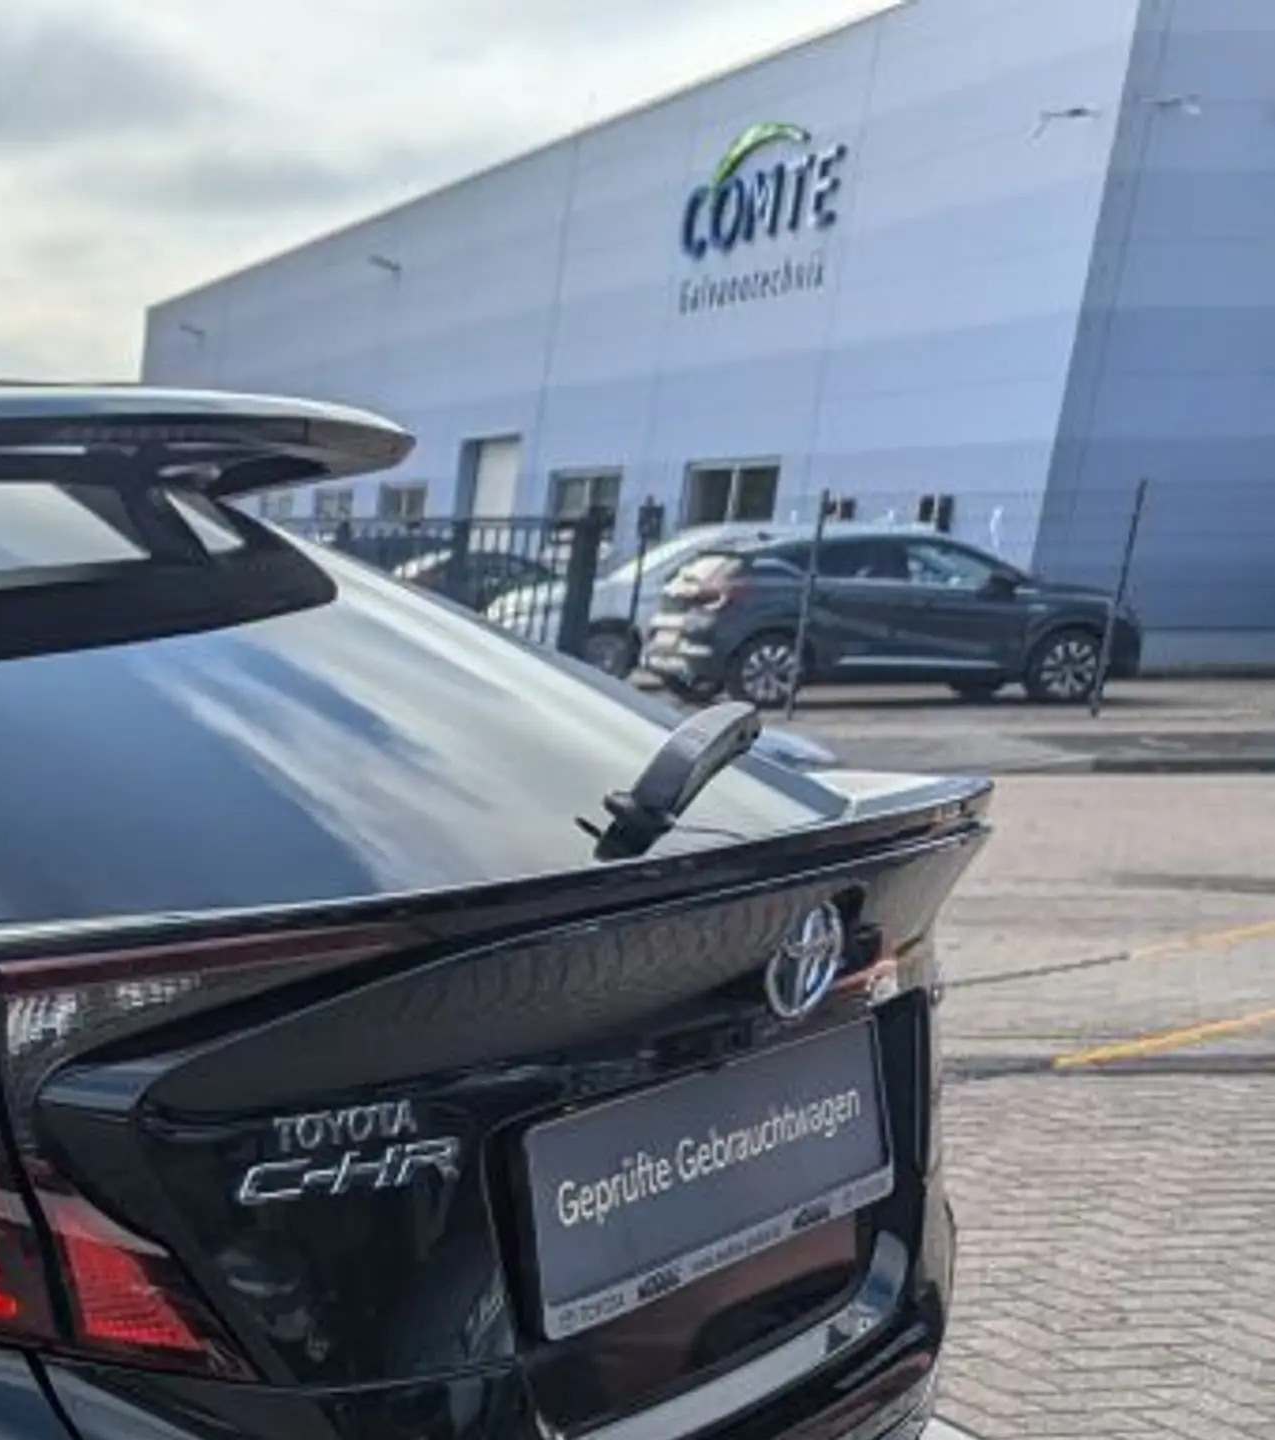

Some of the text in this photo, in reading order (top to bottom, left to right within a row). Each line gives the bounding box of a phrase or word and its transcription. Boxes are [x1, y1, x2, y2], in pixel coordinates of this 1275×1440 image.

[273, 1099, 417, 1152] TOYOTA
[556, 1088, 861, 1227] Geprüfte Gebrauchtwagen
